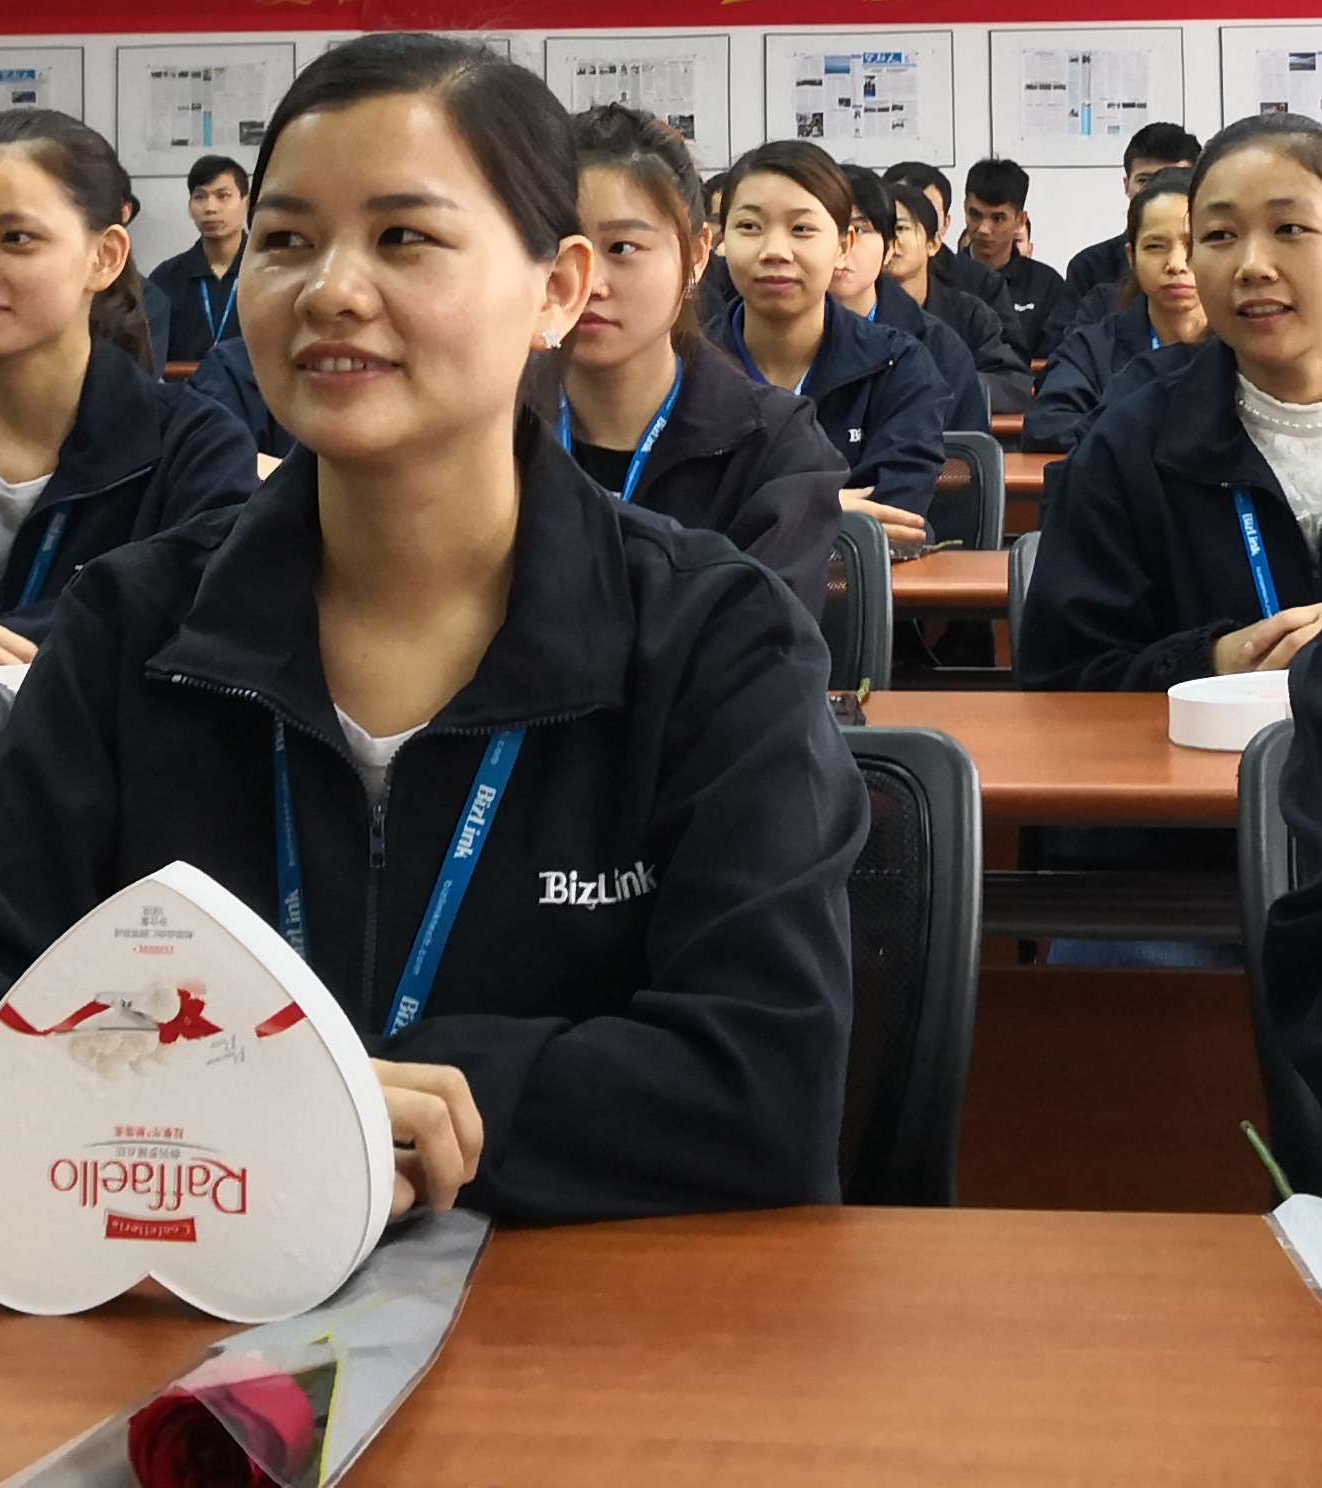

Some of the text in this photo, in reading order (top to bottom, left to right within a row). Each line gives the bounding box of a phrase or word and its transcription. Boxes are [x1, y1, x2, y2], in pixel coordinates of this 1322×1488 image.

[453, 783, 497, 859] BizLink
[537, 860, 658, 908] BizLink
[49, 1157, 249, 1215] Raffaello
